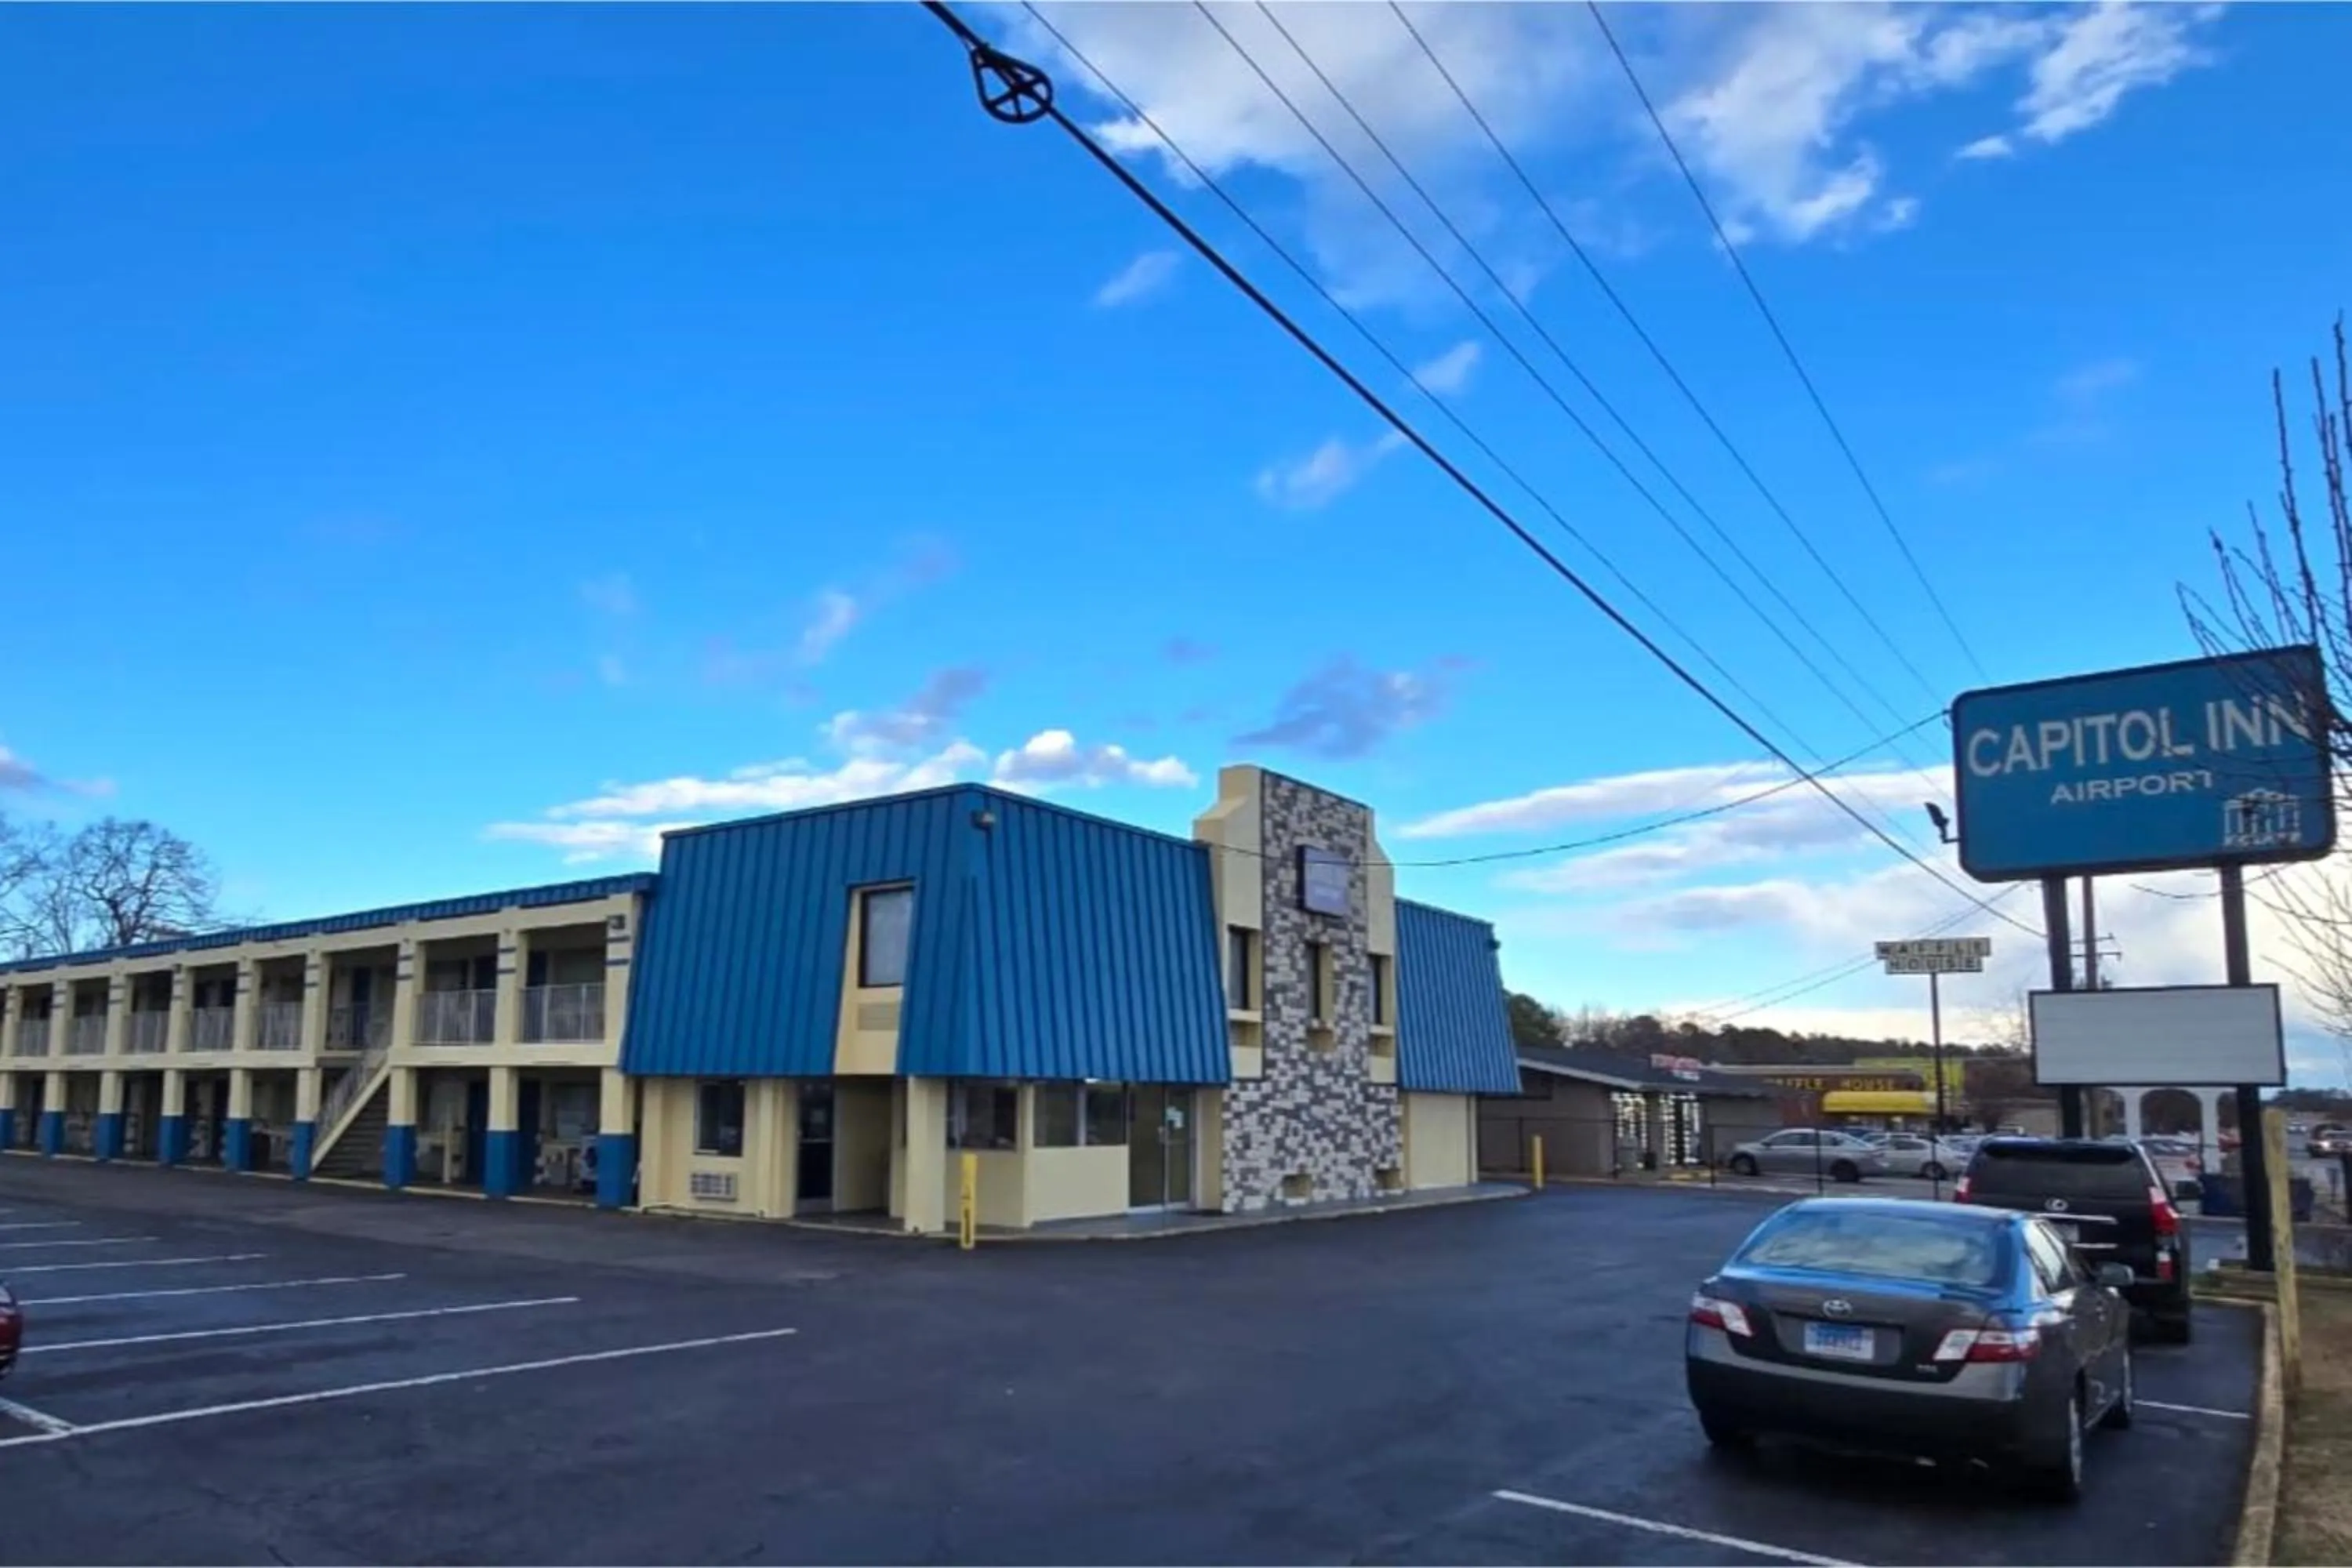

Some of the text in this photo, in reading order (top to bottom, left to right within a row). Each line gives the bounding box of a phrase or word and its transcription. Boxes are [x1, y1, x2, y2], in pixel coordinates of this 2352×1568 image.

[1967, 692, 2312, 777] CAPITOL INN
[2050, 770, 2213, 804] AIRPORT
